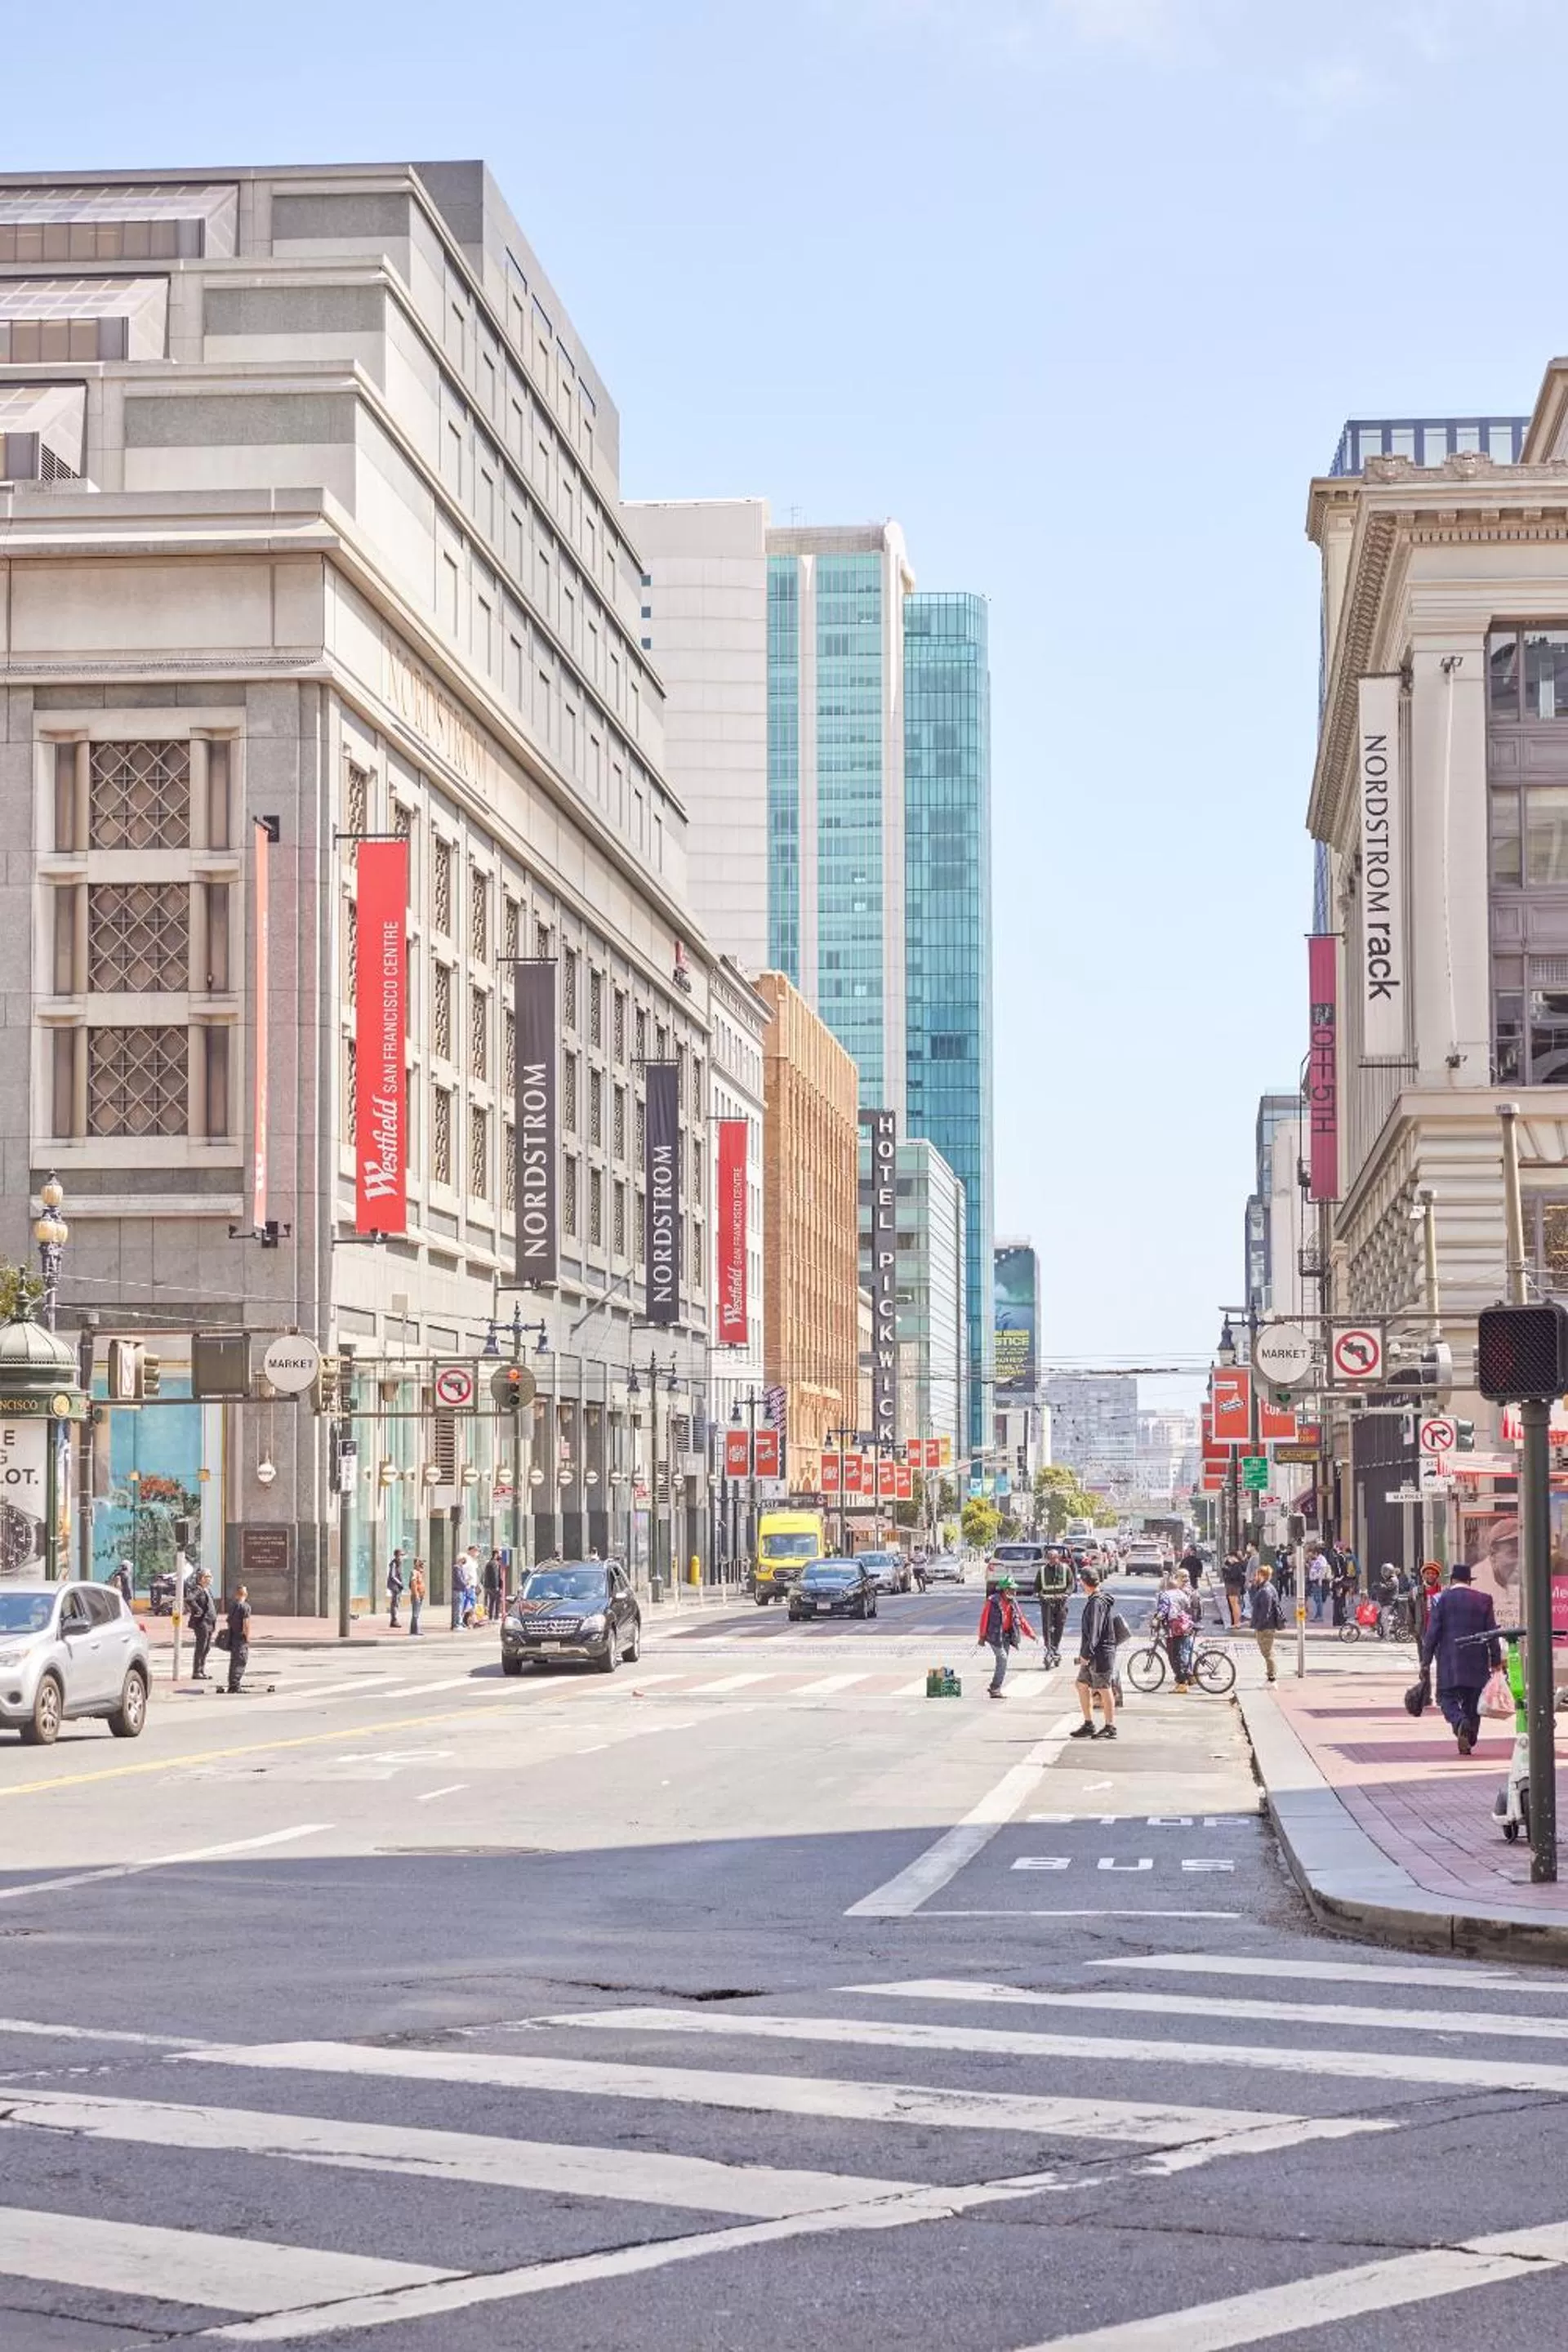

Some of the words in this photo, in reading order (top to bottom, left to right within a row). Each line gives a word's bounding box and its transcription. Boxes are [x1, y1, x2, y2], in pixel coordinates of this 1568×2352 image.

[1364, 734, 1391, 913] NORDSTROM
[383, 920, 399, 977] CENTRE
[1367, 922, 1401, 1000] rack
[382, 981, 399, 1059] FRANCISCO
[382, 1062, 399, 1094] SAN
[1312, 1029, 1335, 1080] OFF
[1312, 1085, 1336, 1134] 5TH
[364, 1094, 398, 1202] Westfield
[523, 1063, 548, 1257] NORDSTROM
[878, 1117, 894, 1230] HOTEL
[653, 1145, 672, 1303] NORDSTROM
[723, 1265, 743, 1327] Westfield
[268, 1358, 314, 1368] MARKET
[878, 1252, 894, 1441] PICKWICK
[1262, 1349, 1307, 1358] MARKET
[4, 1430, 15, 1446] E
[0, 1468, 38, 1485] OT.
[1025, 1813, 1250, 1827] STOP
[1010, 1856, 1236, 1871] BUS
